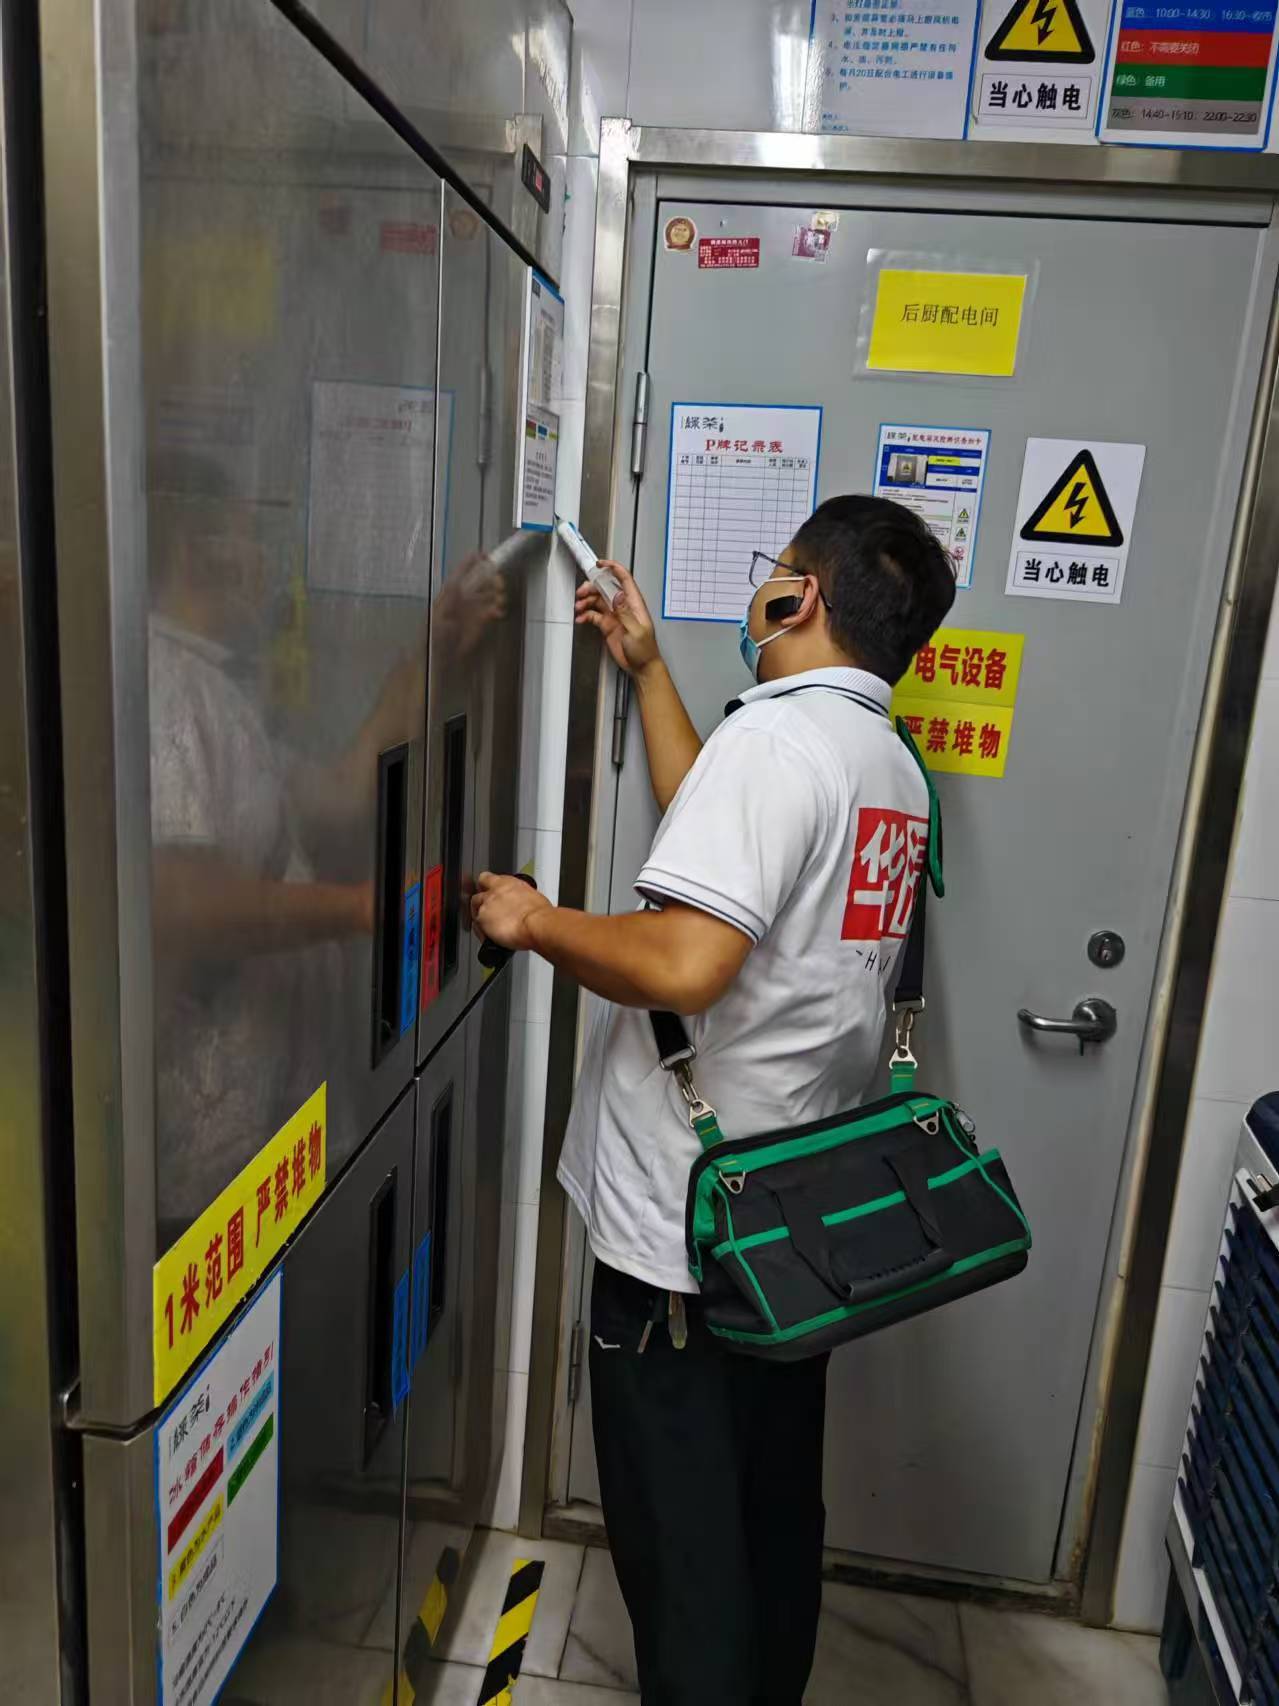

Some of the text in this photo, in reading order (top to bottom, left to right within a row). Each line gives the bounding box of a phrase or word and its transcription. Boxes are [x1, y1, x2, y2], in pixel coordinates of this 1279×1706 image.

[988, 81, 1081, 111] 当心触电
[901, 304, 999, 327] 后厨配电间
[704, 439, 784, 454] P牌记录表
[1022, 558, 1110, 589] 当心触电
[914, 644, 1008, 691] 电气设备
